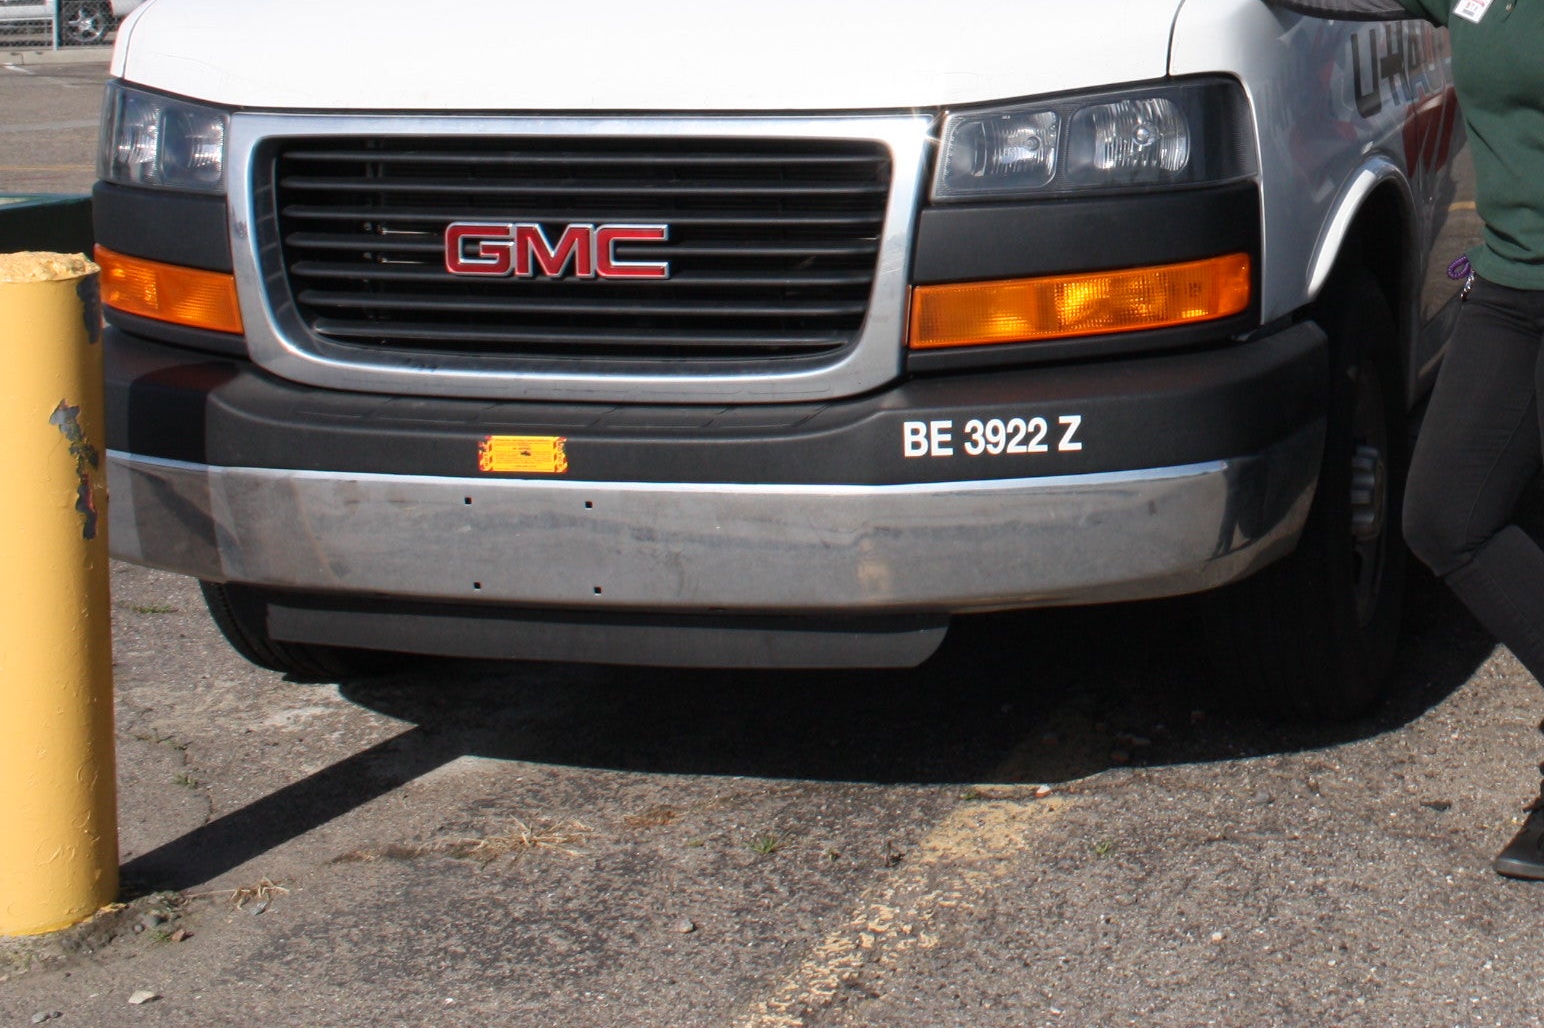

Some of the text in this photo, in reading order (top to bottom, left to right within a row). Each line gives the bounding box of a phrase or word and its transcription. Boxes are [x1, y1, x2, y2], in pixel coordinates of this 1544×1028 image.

[444, 222, 670, 279] GMC
[902, 414, 1083, 458] BE 3922 Z
